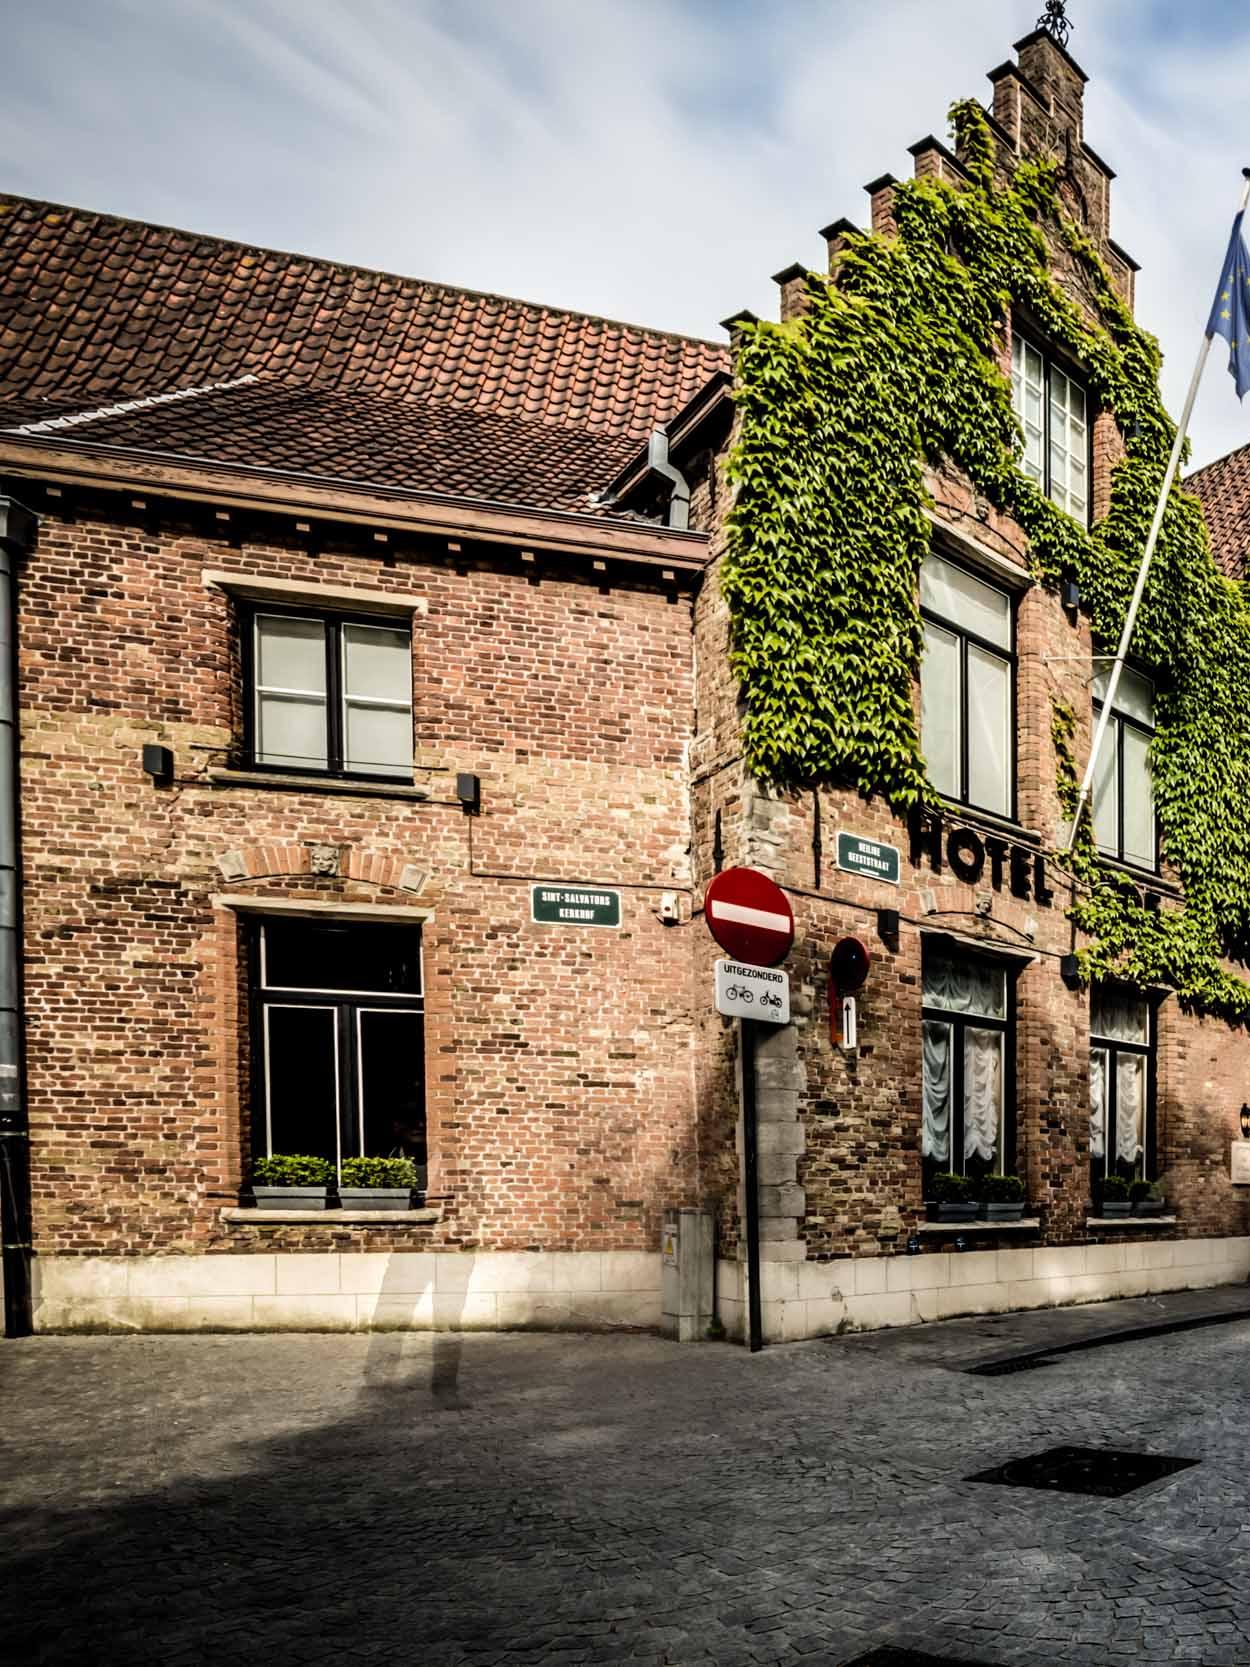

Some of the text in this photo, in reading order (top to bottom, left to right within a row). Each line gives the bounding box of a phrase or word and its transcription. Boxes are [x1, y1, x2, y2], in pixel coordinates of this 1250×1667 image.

[907, 808, 1053, 907] HOTEL
[541, 891, 611, 906] SINT-SALVATORS
[559, 908, 595, 920] KERKHOF
[724, 963, 783, 983] UITGEZONDERD
